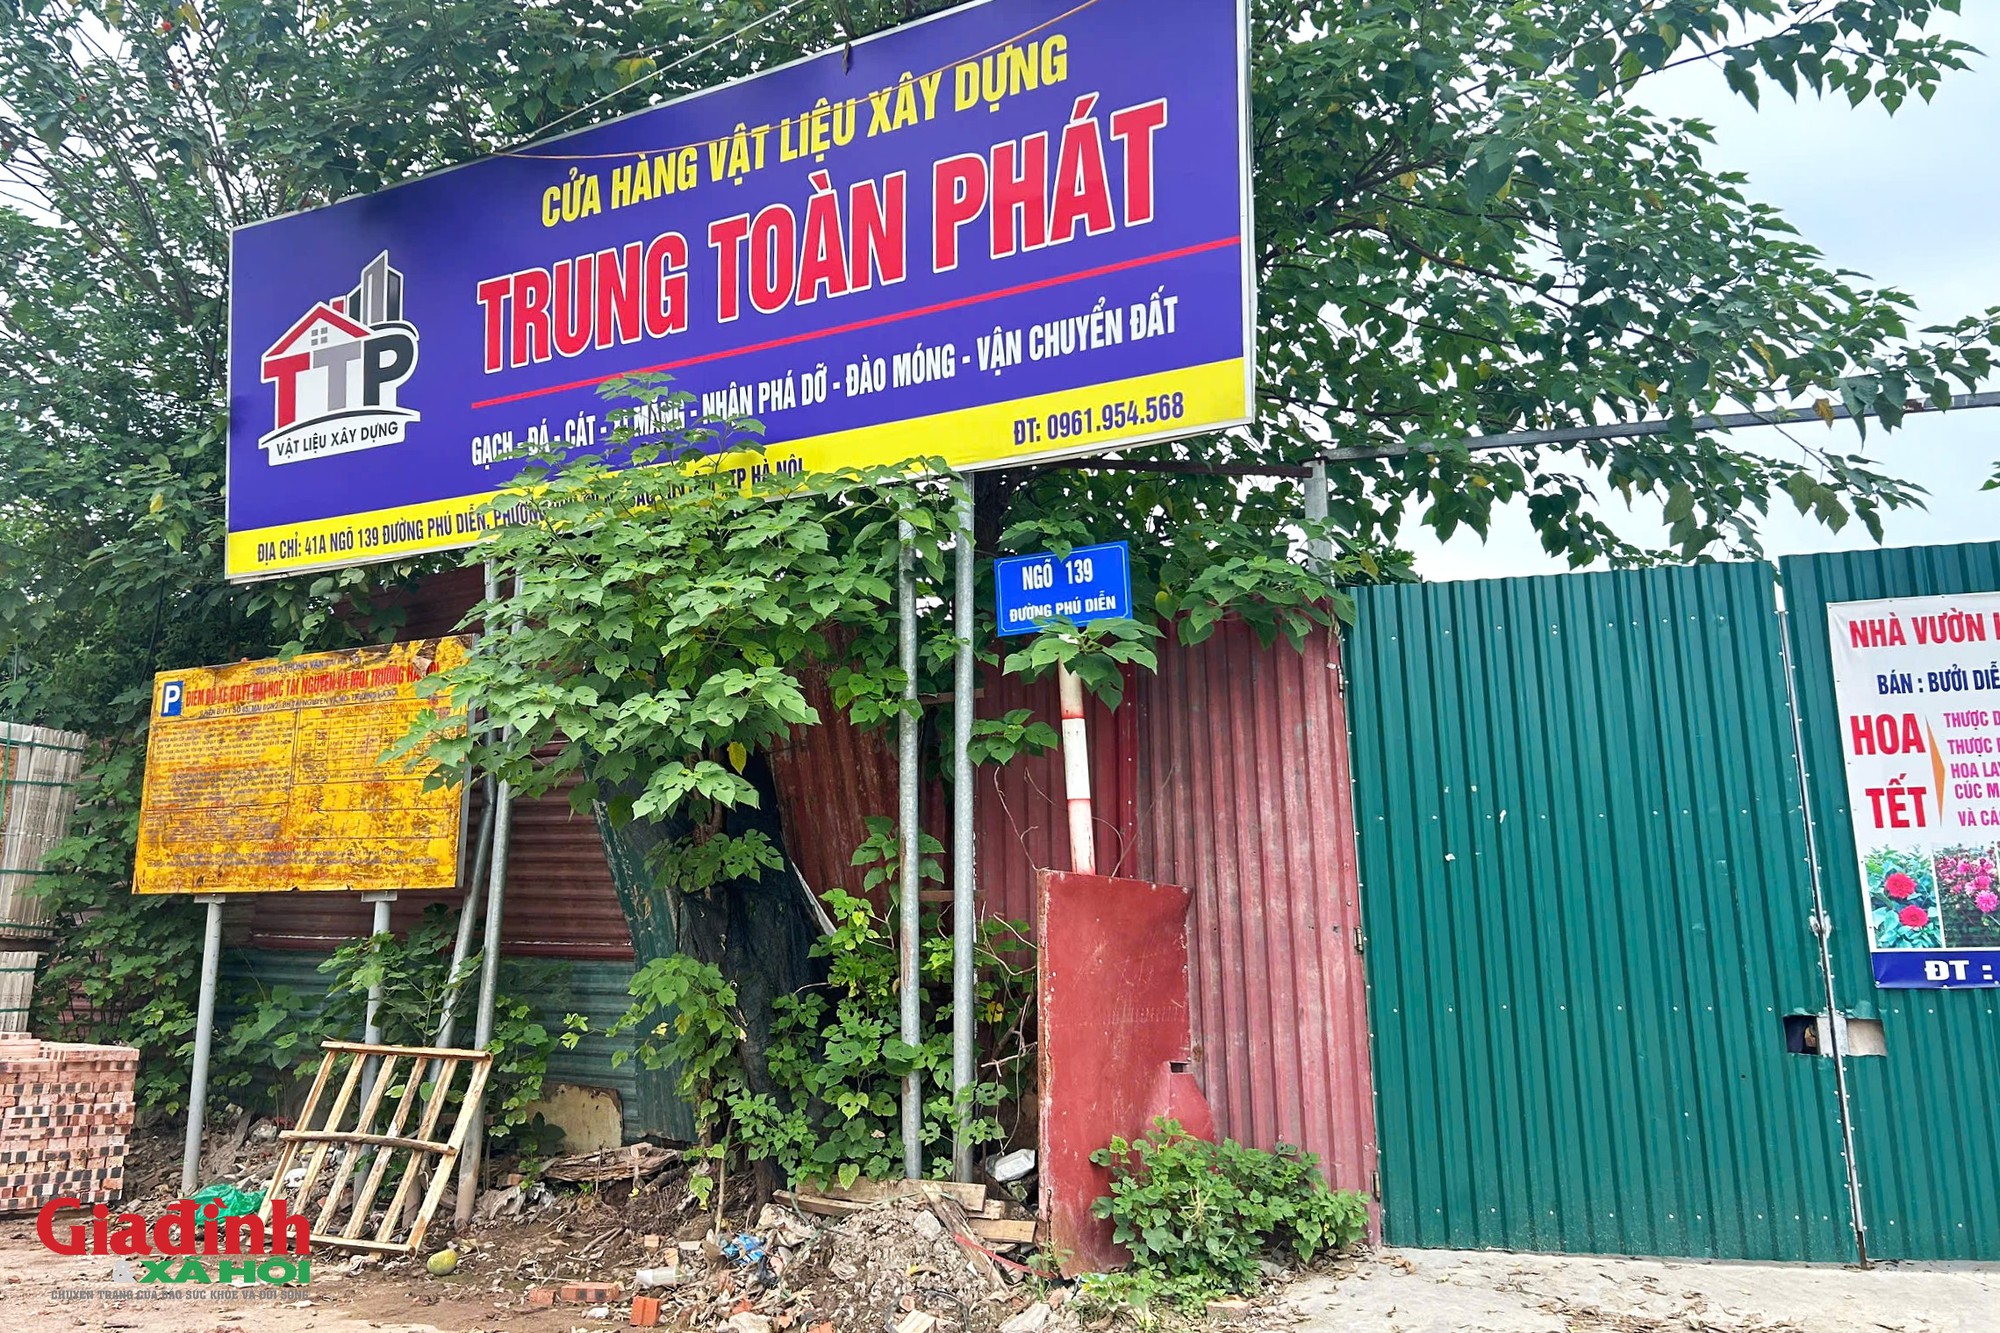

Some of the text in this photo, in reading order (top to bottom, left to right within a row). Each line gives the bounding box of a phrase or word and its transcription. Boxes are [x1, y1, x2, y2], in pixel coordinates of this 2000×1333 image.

[541, 34, 1068, 228] CỬA HÀNG VẬT LIỆU XÂY DỰNG
[477, 91, 1167, 375] TRUNG TOÀN PHÁT
[264, 333, 414, 429] TTP
[472, 431, 513, 470] GẠCH
[527, 418, 550, 456] ĐÁ
[565, 411, 597, 449] CÁT
[633, 396, 685, 438] MĂNG
[758, 370, 796, 414] PHÁ
[801, 363, 828, 406] DỠ
[846, 354, 886, 397] ĐÀO
[892, 343, 956, 388] MÓNG
[976, 326, 1022, 376] VẬN
[1029, 296, 1123, 361] CHUYỂN
[1130, 285, 1178, 341] ĐẤT
[1013, 391, 1184, 446] ĐT: 0961.954.568
[276, 421, 399, 459] VẬT LIỆU XÂY DỰNG
[257, 543, 276, 566] ĐỊA
[279, 532, 301, 559] CHỈ:
[304, 534, 327, 555] 41A
[330, 526, 354, 552] NGÕ
[358, 527, 379, 549] 139
[382, 517, 424, 545] ĐƯỜNG
[427, 511, 452, 539] PHÚ
[728, 468, 746, 489] TP
[751, 458, 770, 485] HÀ
[1022, 558, 1093, 591] NGÕ 139
[1009, 590, 1116, 622] ĐƯỜNG PHÚ DIỄN
[1848, 612, 1907, 648] NHÀ
[1911, 608, 1986, 645] VƯỜN
[1876, 669, 1913, 695] BÁN
[1927, 664, 1967, 693] BƯỞI
[1850, 713, 1927, 756] HOA
[1943, 711, 1989, 730] THƯỢC
[1947, 737, 1992, 757] THƯỢC
[1951, 761, 2000, 779] HOA LA
[1865, 773, 1927, 829] TẾT
[1954, 779, 1982, 800] CÚC
[1958, 806, 2000, 827] VÀ CÁ
[1924, 959, 1969, 981] ĐT
